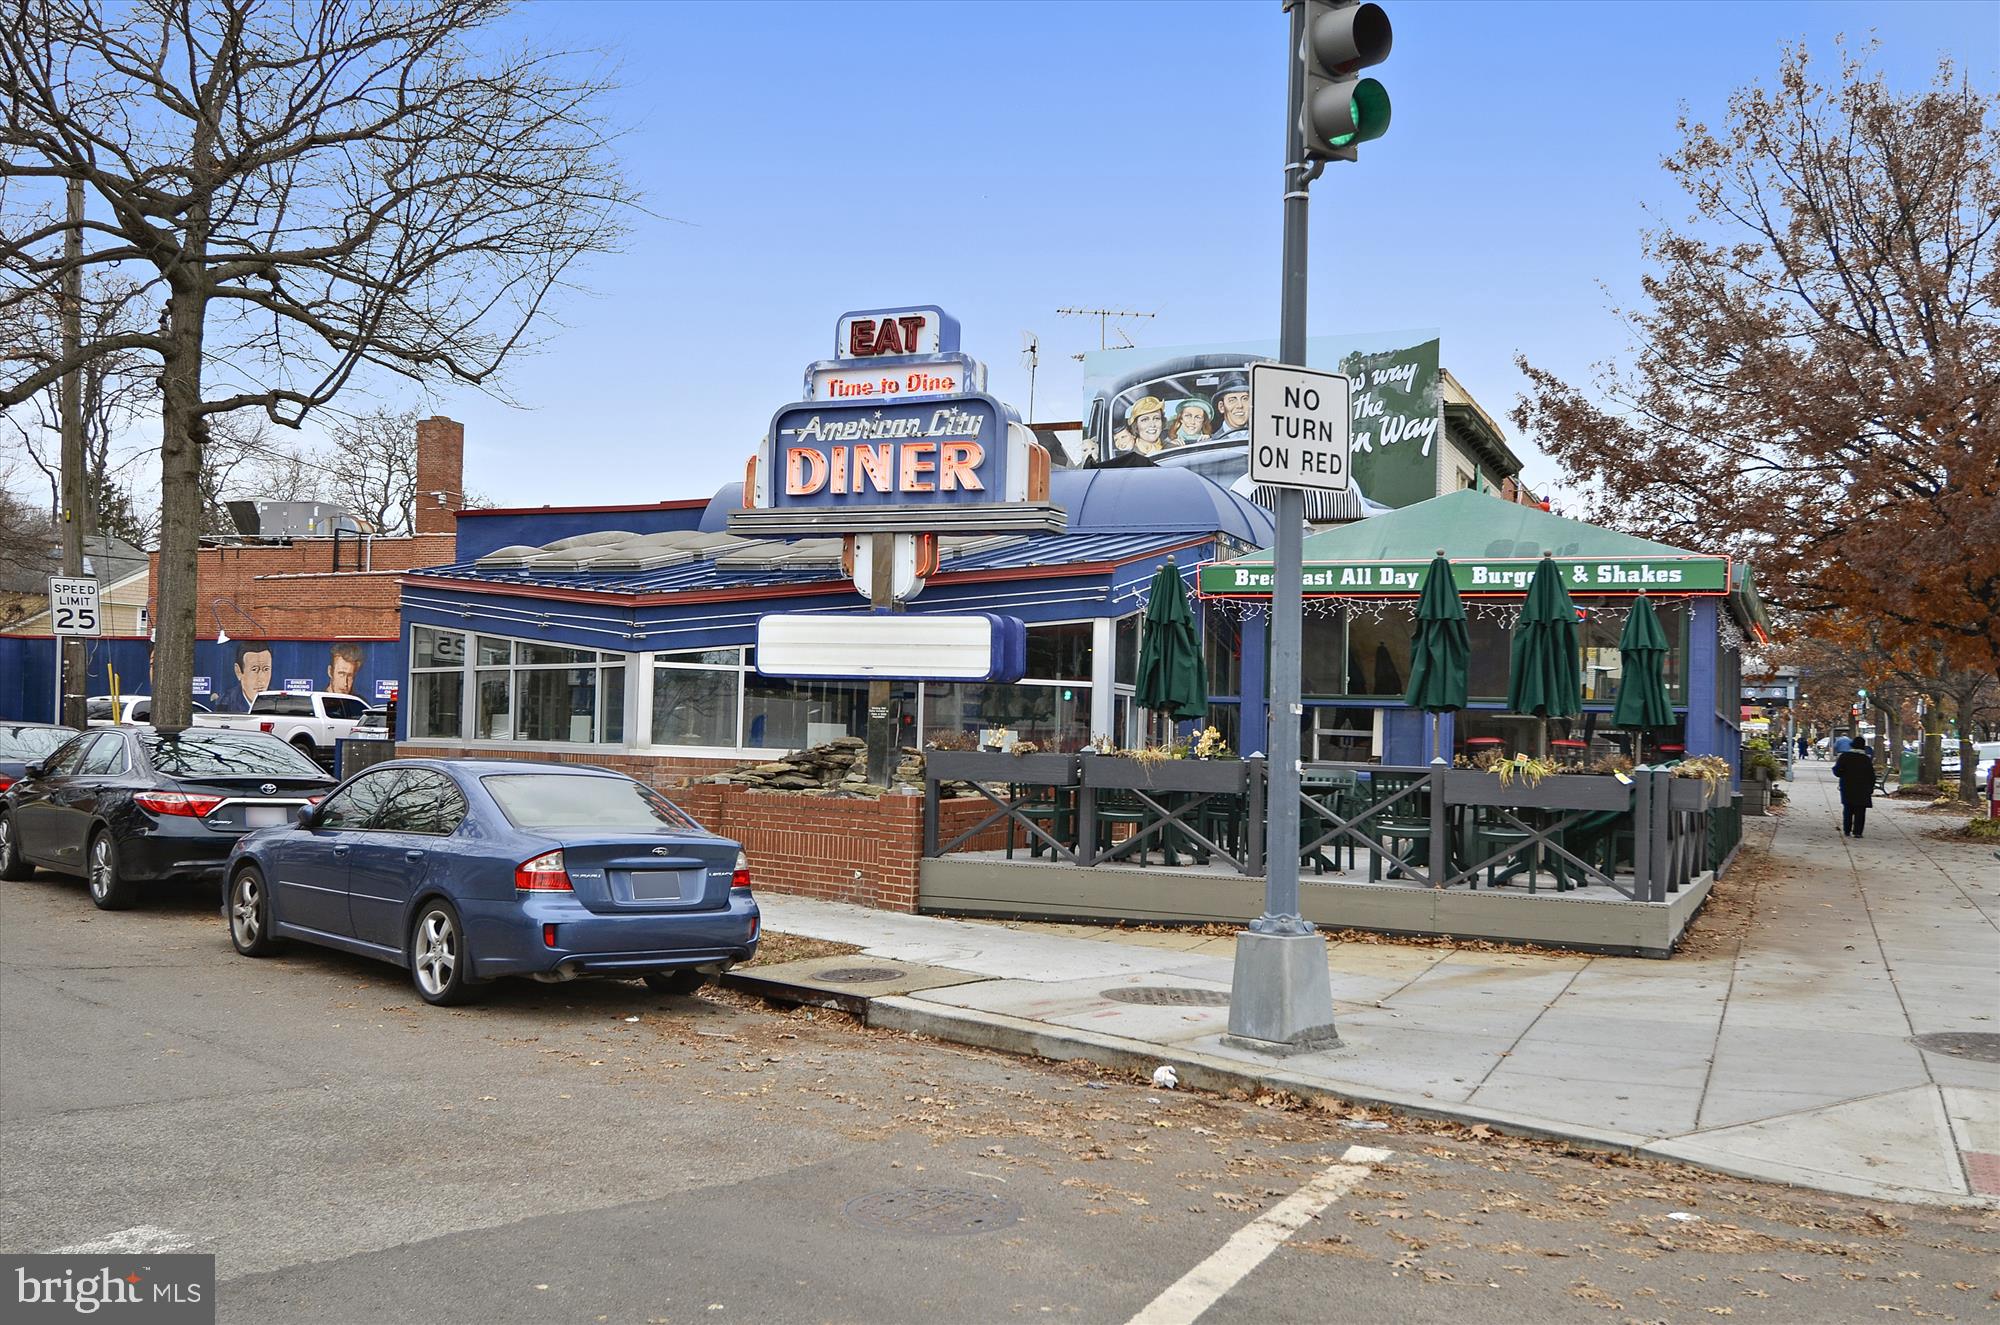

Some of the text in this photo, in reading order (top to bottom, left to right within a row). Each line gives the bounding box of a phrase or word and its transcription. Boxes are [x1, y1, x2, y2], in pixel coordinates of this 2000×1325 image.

[850, 316, 925, 356] EAT
[828, 373, 953, 397] Time to Dine
[1371, 363, 1418, 393] way
[1284, 386, 1320, 411] NO
[1353, 392, 1384, 420] the
[782, 406, 984, 442] American City
[1271, 415, 1332, 442] TURN
[1379, 415, 1439, 457] Way
[786, 441, 985, 495] DINER
[1259, 445, 1342, 475] ON RED
[54, 584, 96, 595] SPEED
[1235, 569, 1333, 586] Breast
[1340, 568, 1372, 585] All
[1379, 567, 1419, 589] Day
[1572, 565, 1589, 583] &
[1597, 564, 1682, 583] Shakes
[59, 596, 91, 606] LIMIT
[56, 608, 96, 630] 25
